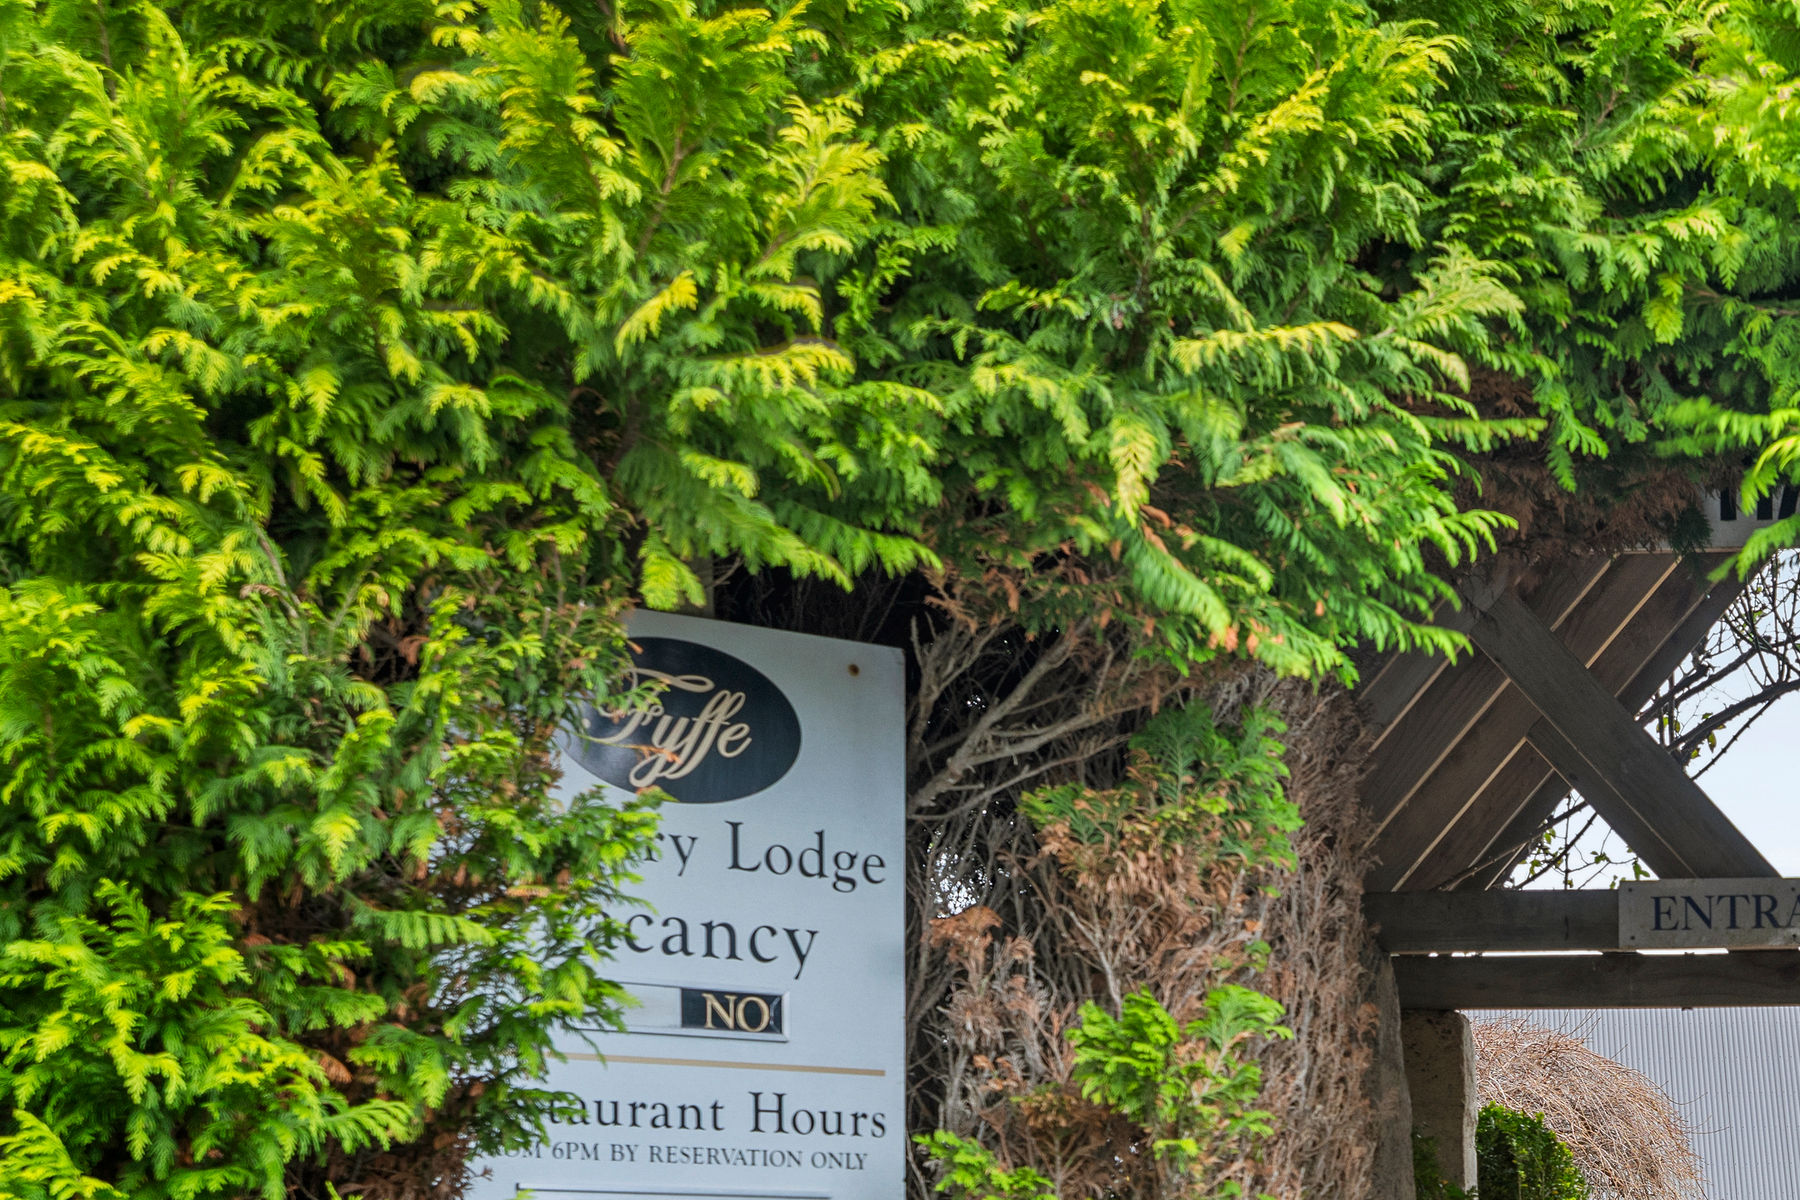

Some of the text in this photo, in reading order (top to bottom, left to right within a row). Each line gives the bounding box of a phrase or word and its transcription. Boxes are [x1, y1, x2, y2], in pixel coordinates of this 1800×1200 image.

[725, 819, 886, 893] Lodge
[702, 992, 771, 1033] NO
[548, 1091, 887, 1139] taurant Hours
[552, 1141, 600, 1162] 6PM
[610, 1143, 639, 1163] BY
[649, 1145, 802, 1168] RESERVATION
[811, 1151, 868, 1171] ONLY
